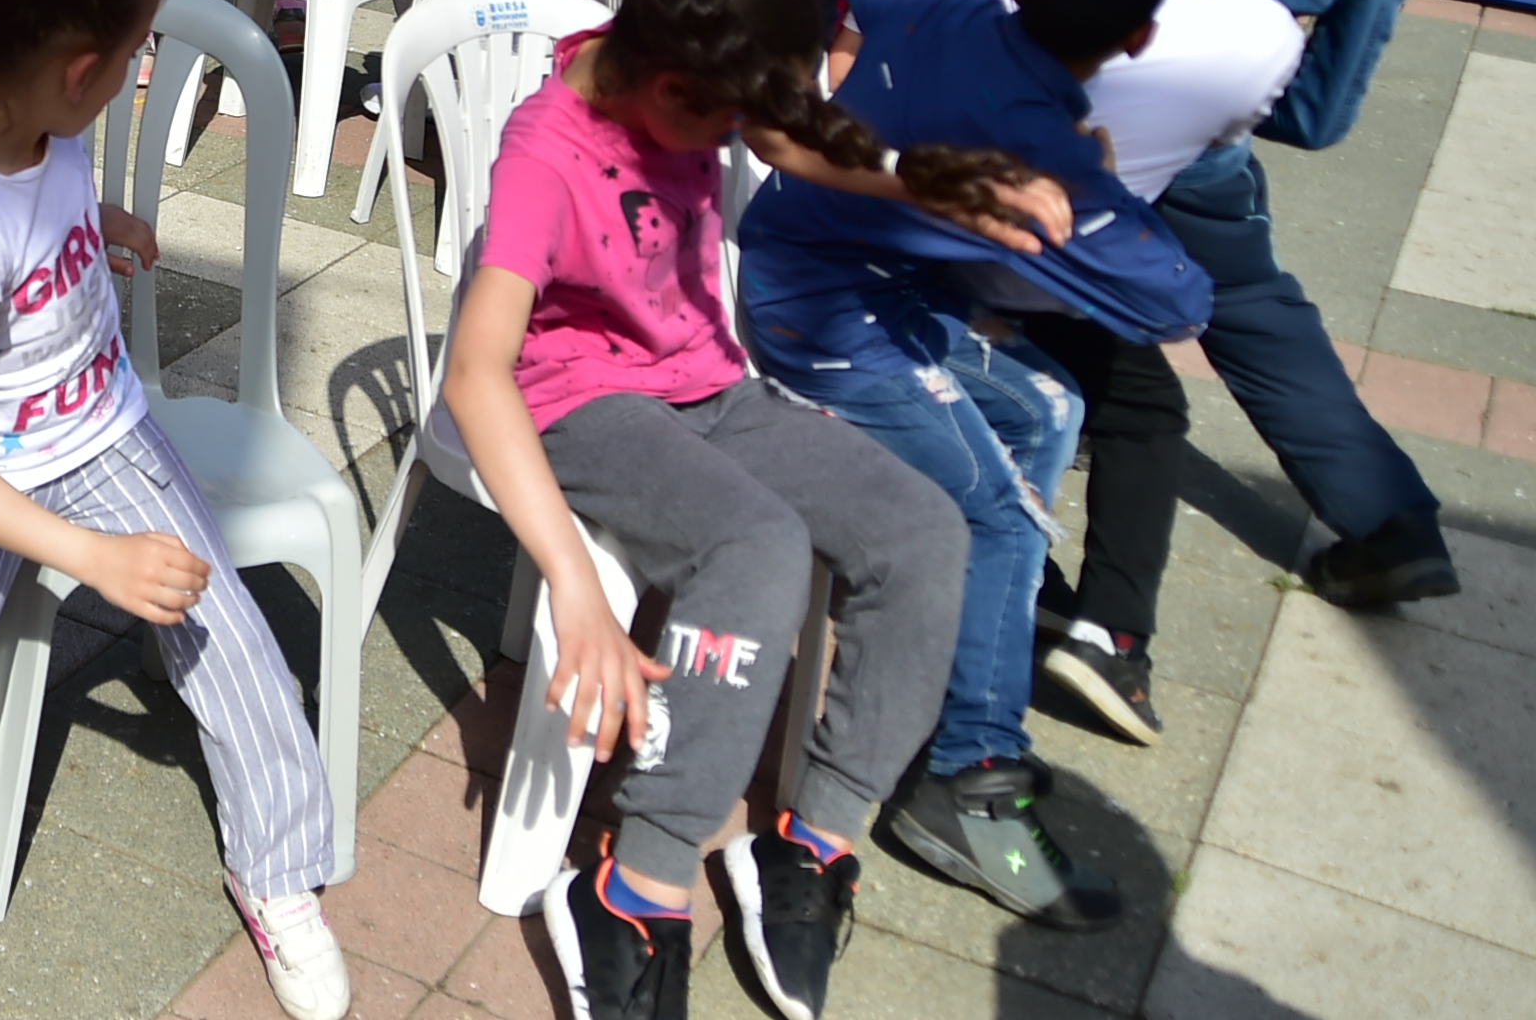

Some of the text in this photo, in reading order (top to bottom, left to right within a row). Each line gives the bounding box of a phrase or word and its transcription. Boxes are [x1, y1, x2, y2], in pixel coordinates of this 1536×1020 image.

[489, 1, 527, 13] BURSA
[13, 333, 121, 433] FUN
[669, 624, 762, 691] TIME
